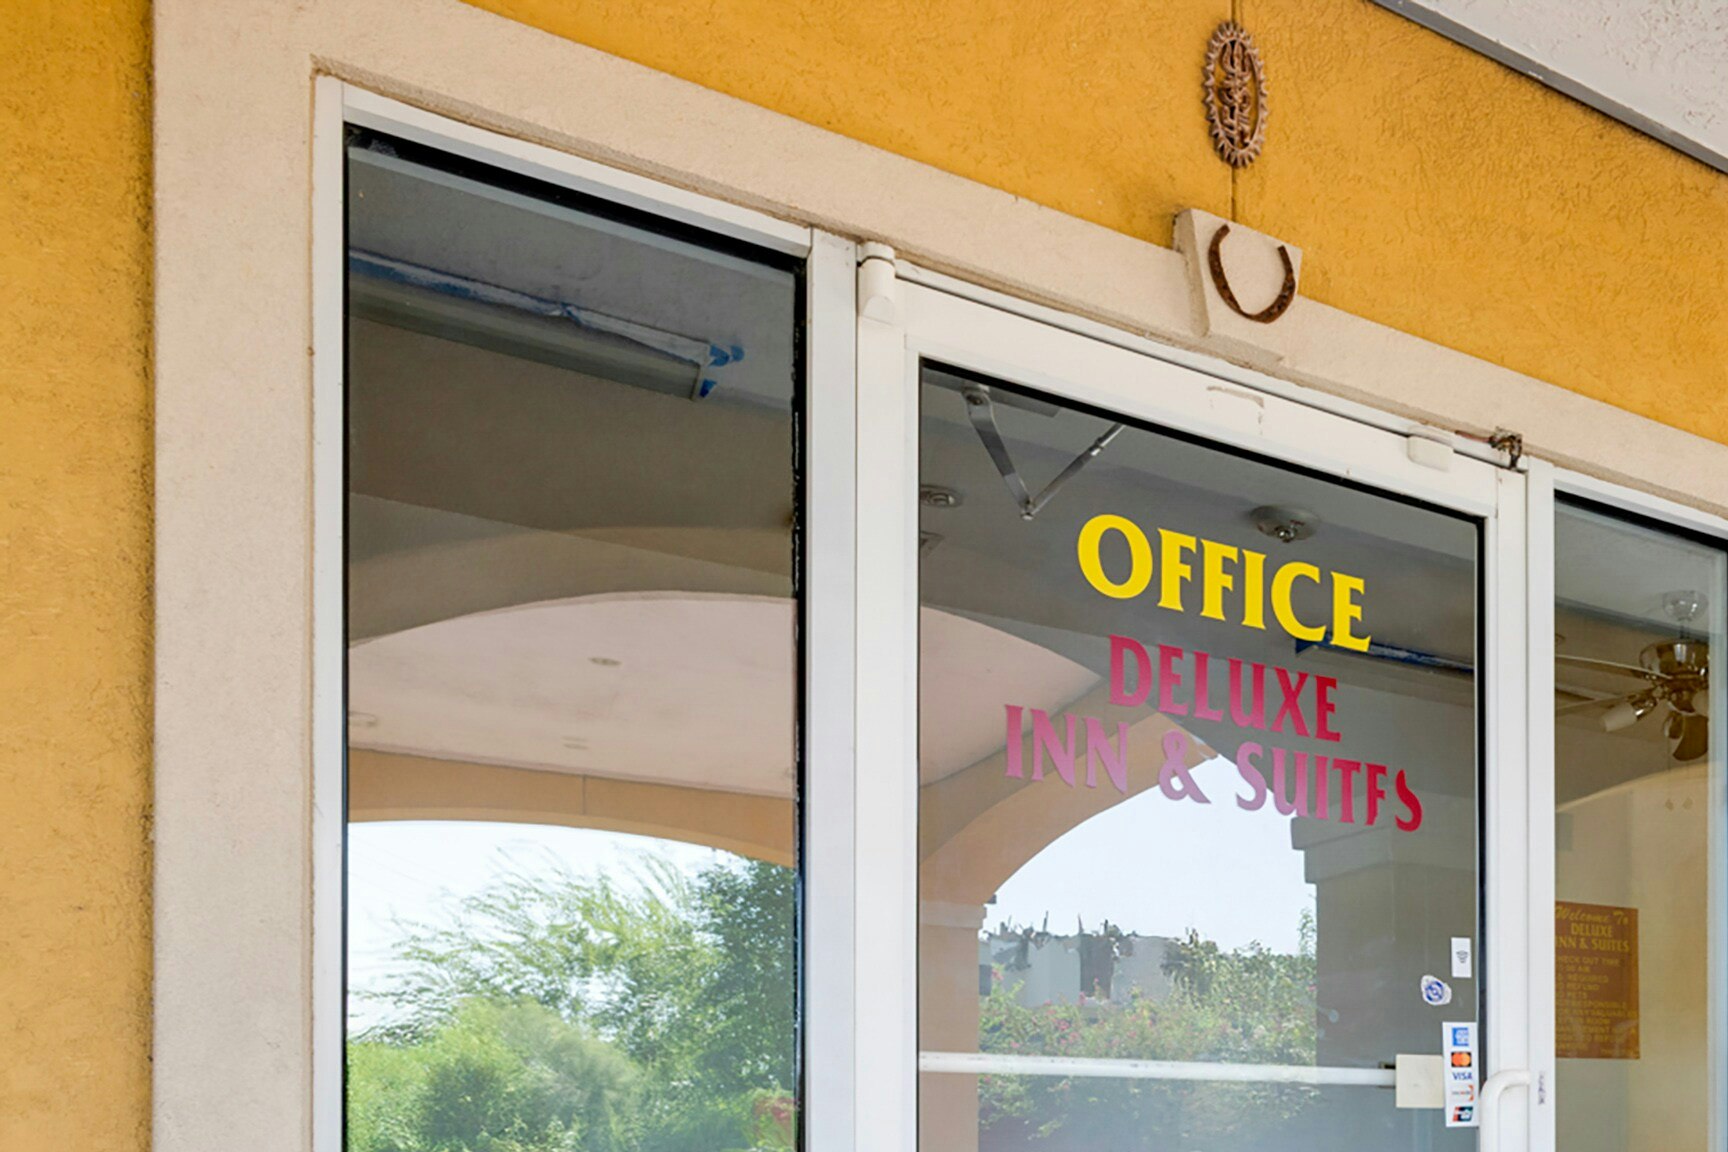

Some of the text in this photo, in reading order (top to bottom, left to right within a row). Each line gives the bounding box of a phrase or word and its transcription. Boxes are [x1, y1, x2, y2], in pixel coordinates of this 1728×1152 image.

[1078, 514, 1372, 651] OFFICE
[1109, 634, 1342, 743] DELUXE
[1004, 704, 1128, 795] INN
[1159, 731, 1211, 804] &
[1571, 923, 1613, 937] DELUXE
[1580, 938, 1588, 949] &
[1592, 938, 1630, 952] SUITES
[1452, 1072, 1473, 1080] VISA
